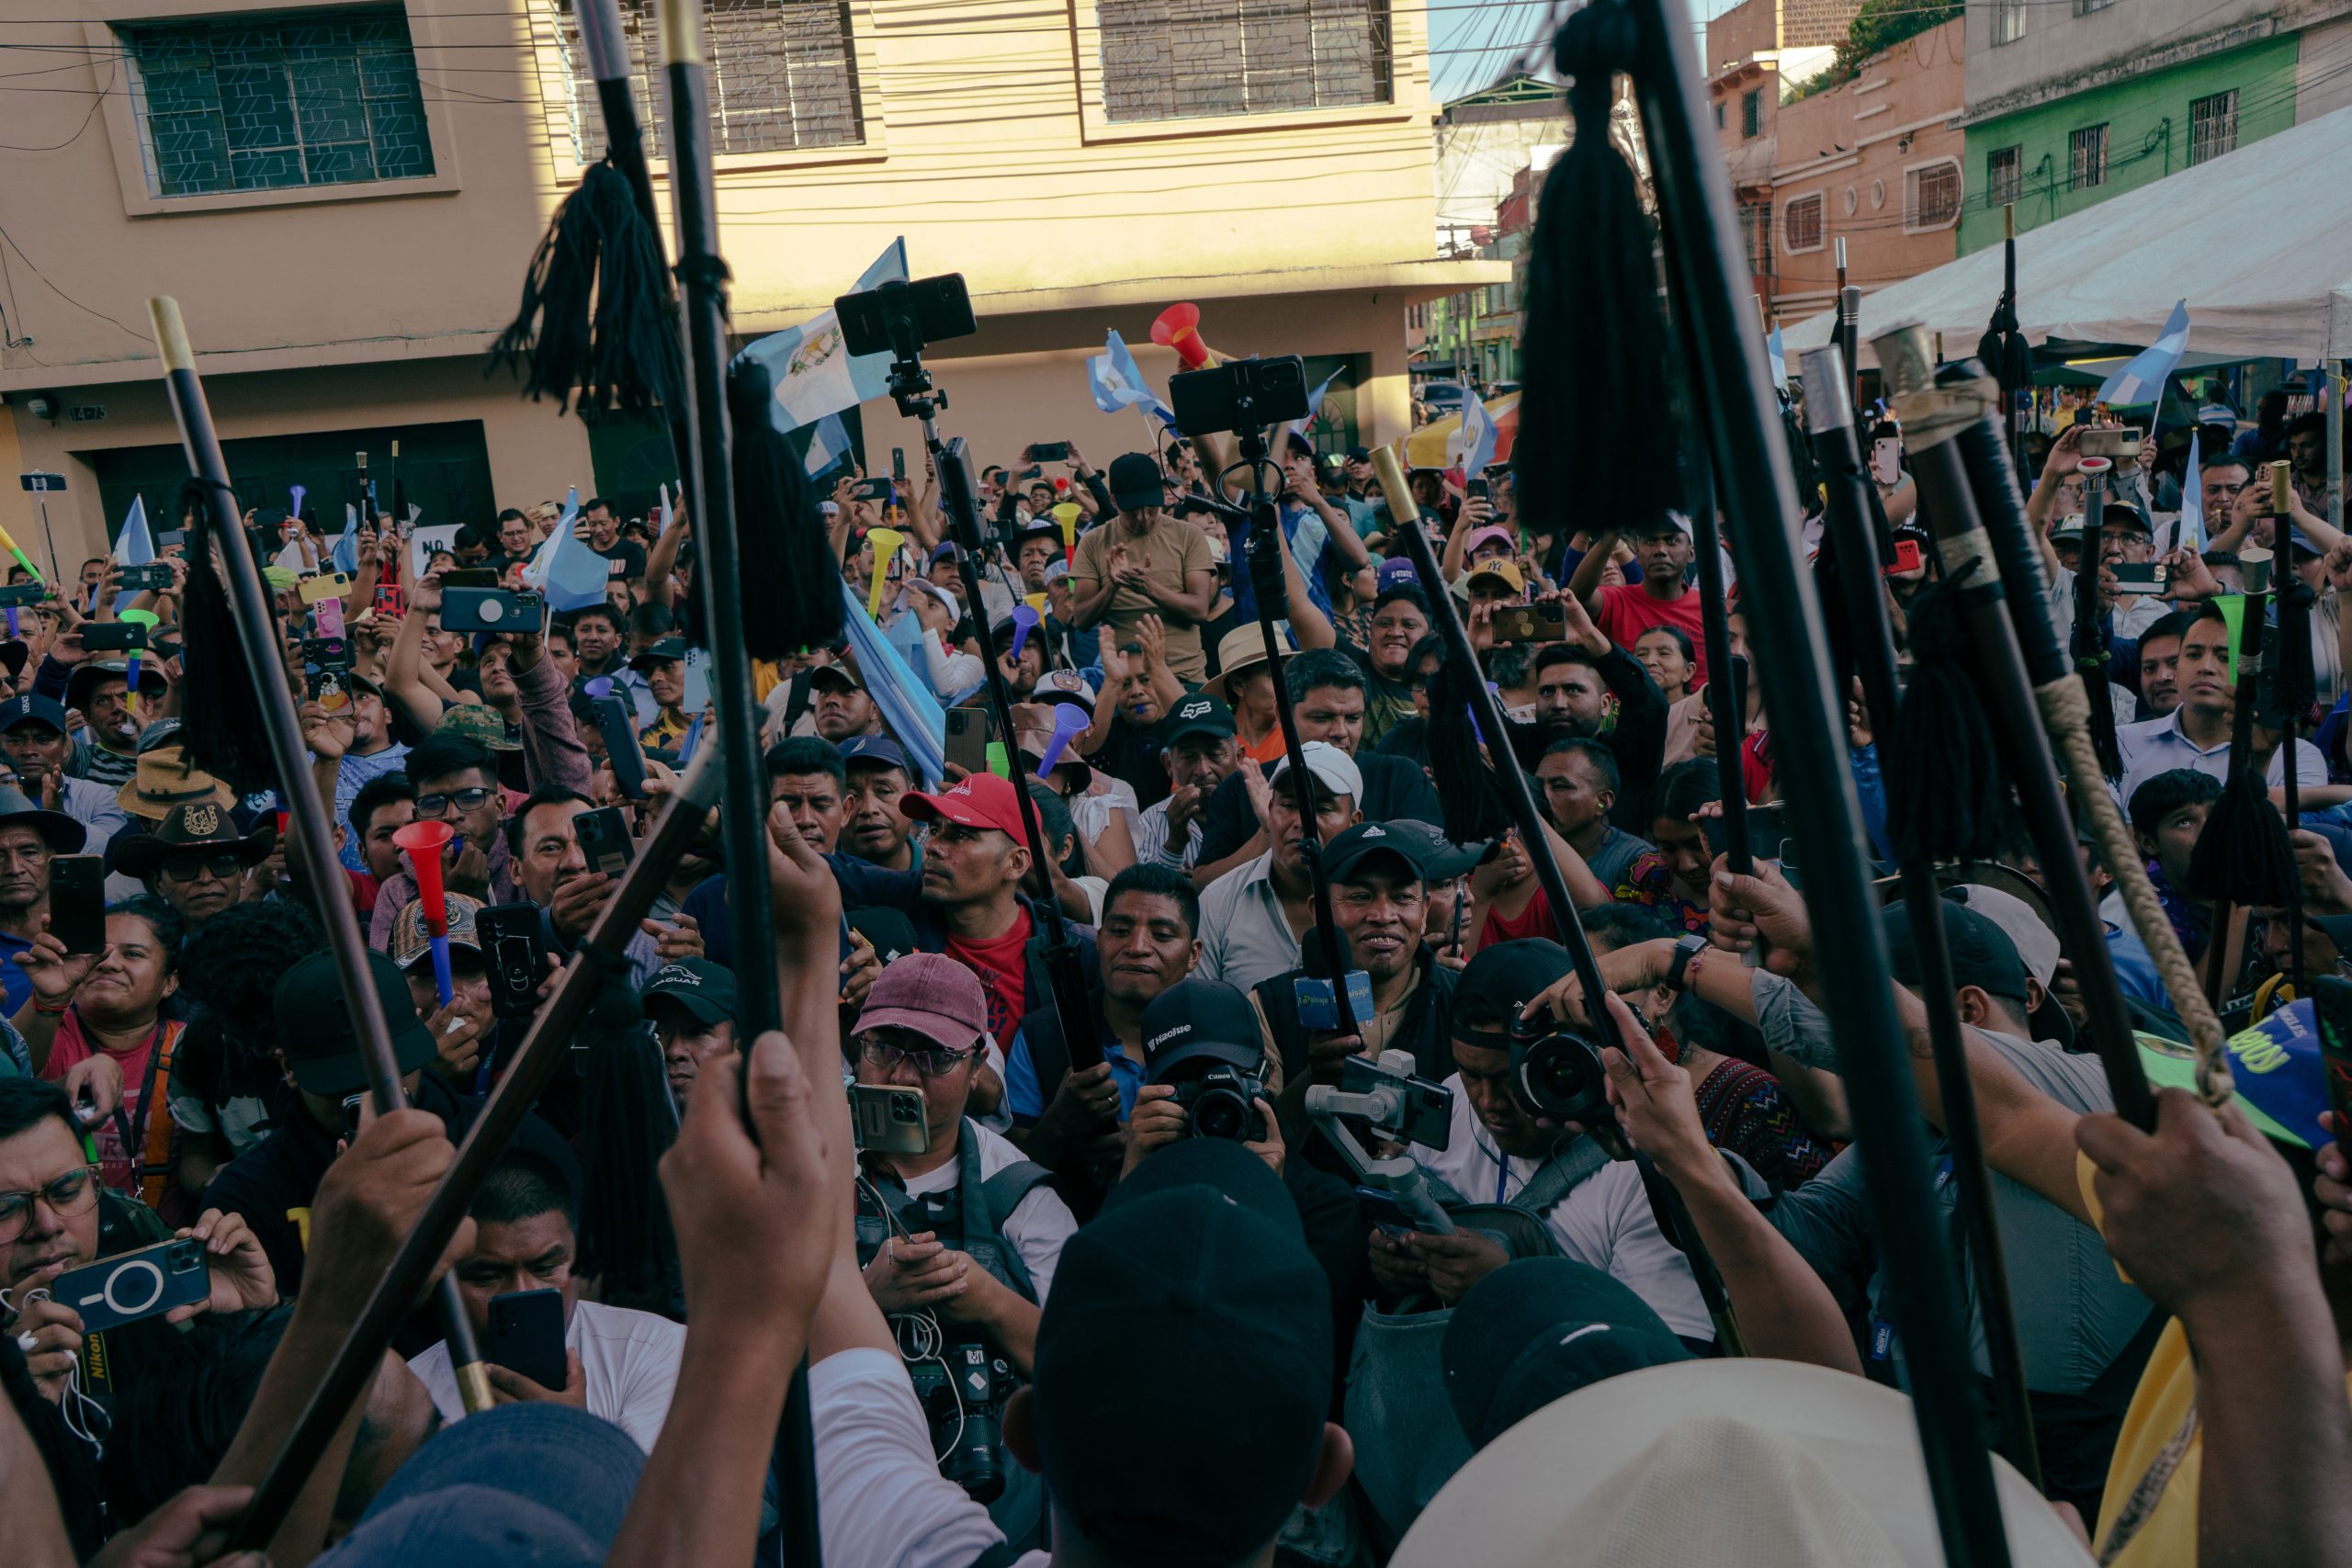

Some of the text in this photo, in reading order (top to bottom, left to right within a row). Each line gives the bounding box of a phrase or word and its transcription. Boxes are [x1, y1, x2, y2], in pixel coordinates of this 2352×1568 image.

[1487, 560, 1502, 571] NY
[651, 976, 701, 988] JAGUAR
[1155, 1024, 1191, 1045] HaoJue
[88, 1333, 105, 1380] Nikon
